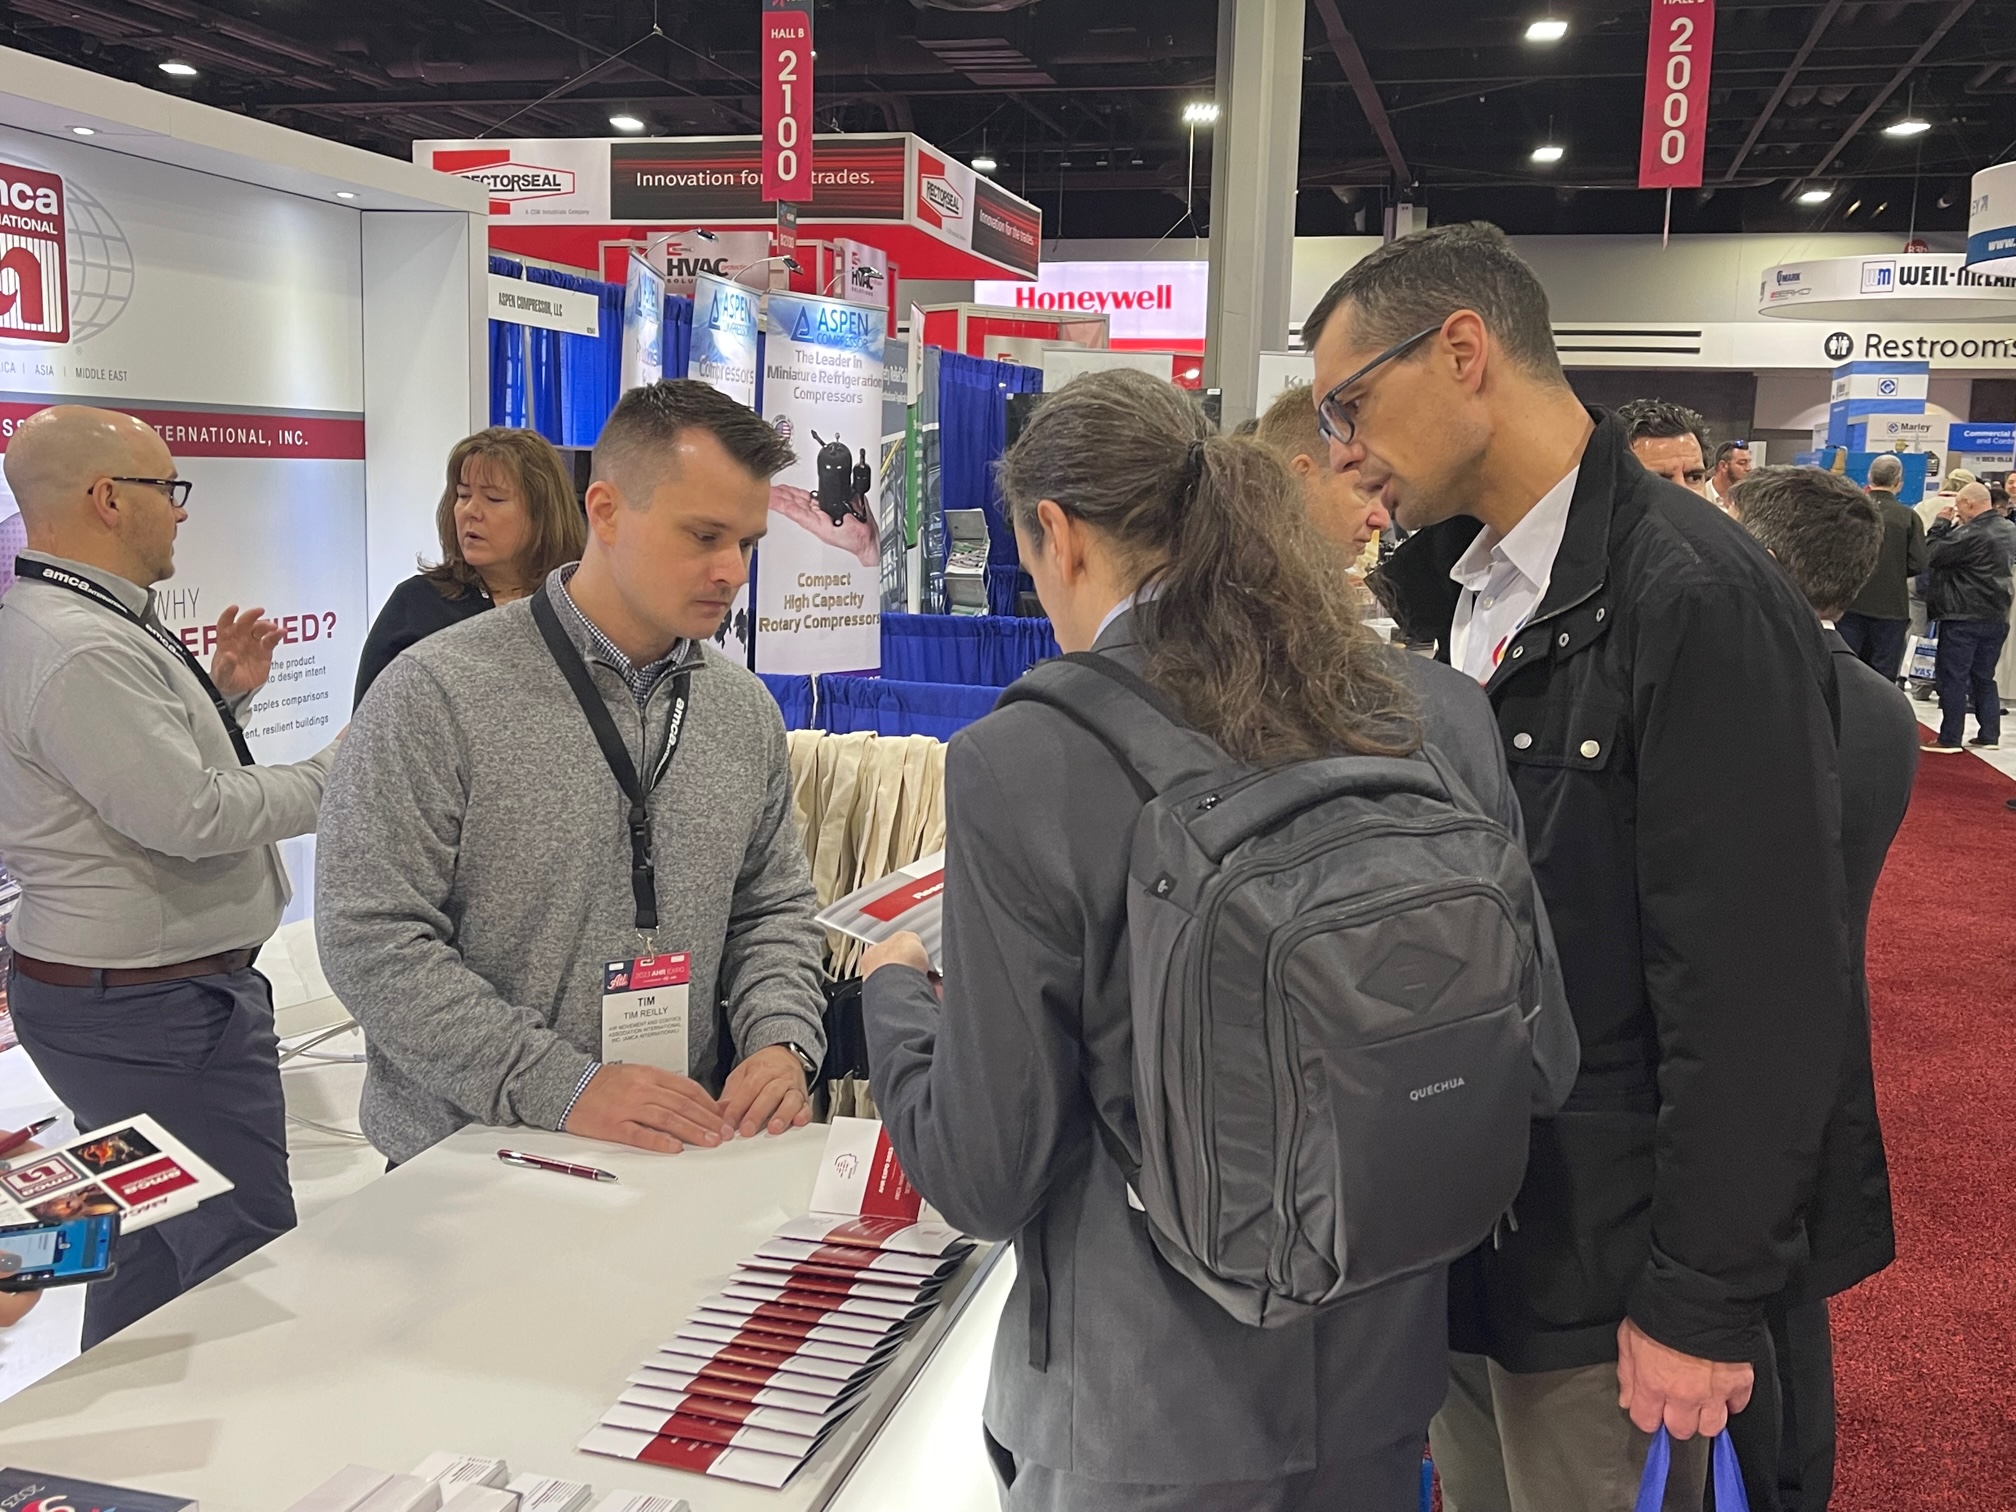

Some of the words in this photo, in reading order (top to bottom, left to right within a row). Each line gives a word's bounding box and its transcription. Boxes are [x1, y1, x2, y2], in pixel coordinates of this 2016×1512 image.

[771, 28, 796, 39] HALL
[798, 28, 805, 38] B
[1661, 16, 1694, 165] 2000
[777, 49, 797, 181] 2100
[636, 170, 734, 186] Innovation
[811, 169, 875, 185] trades.
[980, 209, 1004, 233] Innovation
[667, 258, 729, 277] HVAC
[499, 292, 516, 308] ASPEN
[516, 296, 552, 318] COMPRESSOR,
[554, 303, 562, 316] LLC
[1015, 284, 1173, 313] Honeywell
[722, 292, 752, 324] ASPEN
[817, 308, 869, 336] ASPEN
[816, 332, 868, 349] COMPRESSOR
[796, 350, 814, 365] The
[816, 351, 852, 369] Leader
[853, 354, 862, 369] in
[35, 364, 55, 377] ASIA
[75, 367, 106, 380] MIDDLE
[108, 370, 128, 382] EAST
[700, 356, 754, 385] Compressors
[767, 365, 817, 382] Miniature
[818, 370, 882, 389] Refrigeration
[794, 386, 863, 404] Compressors
[1900, 423, 1930, 432] Marley
[1964, 430, 2010, 438] Commercial
[278, 432, 309, 446] INC.
[42, 568, 90, 591] amca
[798, 572, 852, 590] Compact
[784, 594, 810, 612] High
[812, 592, 864, 611] Capacity
[758, 618, 802, 634] Rotary
[804, 613, 880, 631] Compressors
[271, 660, 284, 670] the
[286, 655, 316, 671] product
[278, 670, 302, 684] design
[304, 666, 326, 677] intent
[282, 690, 329, 706] comparisons
[262, 721, 294, 736] resilient
[296, 715, 329, 730] buildings
[668, 697, 685, 746] amca
[651, 969, 666, 978] AHR
[666, 966, 685, 976] EXPO
[638, 996, 656, 1007] TIM
[624, 1011, 638, 1020] TIM
[640, 1006, 669, 1018] REILLY
[608, 1028, 642, 1038] ASSOCIATION
[618, 1021, 647, 1030] MOVEMENT
[1410, 1077, 1466, 1101] QUECHUA
